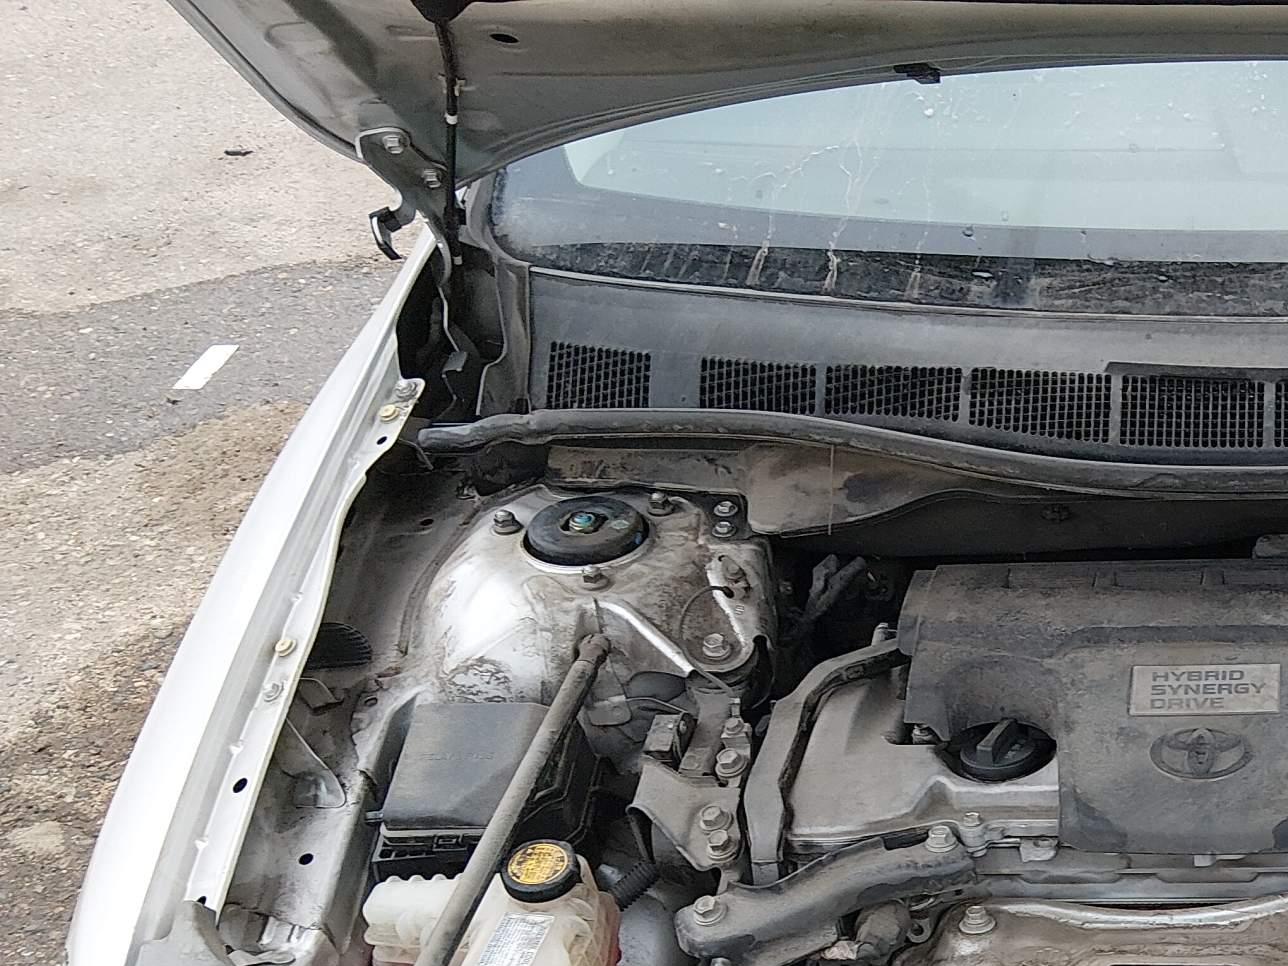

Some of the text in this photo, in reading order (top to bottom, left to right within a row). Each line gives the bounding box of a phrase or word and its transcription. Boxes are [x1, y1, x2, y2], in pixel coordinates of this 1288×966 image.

[1152, 670, 1244, 682] HYBRID
[1151, 683, 1266, 695] SYNERGY
[1150, 697, 1225, 710] DRIVE
